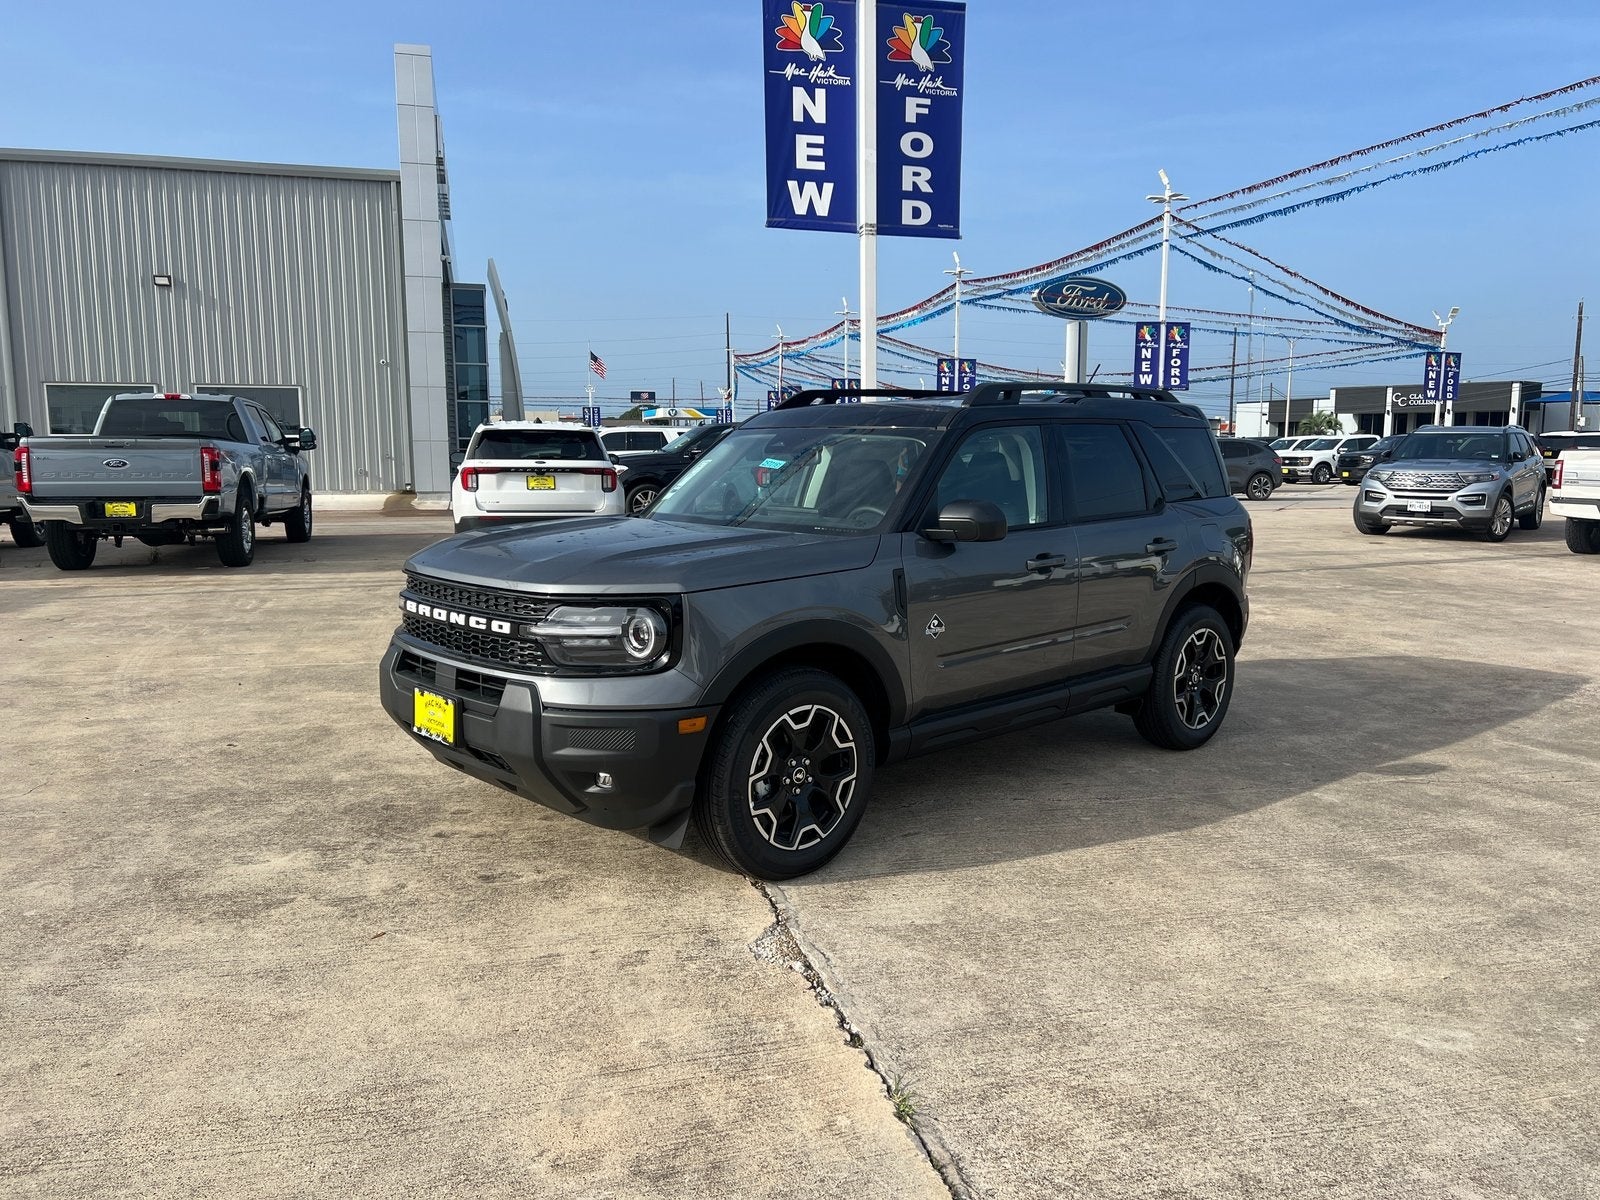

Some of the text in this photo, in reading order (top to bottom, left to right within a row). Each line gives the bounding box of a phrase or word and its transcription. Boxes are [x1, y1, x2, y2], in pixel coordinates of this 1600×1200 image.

[783, 62, 844, 83] Mac Haik
[816, 77, 851, 86] VICTORIA
[893, 72, 951, 94] Mac Haik
[924, 88, 958, 97] VICTORIA
[786, 86, 834, 217] NEW
[899, 96, 934, 226] FORD
[1055, 284, 1109, 309] Ford
[1139, 348, 1153, 385] NEW
[1170, 348, 1181, 386] FORD
[1426, 371, 1436, 399] NEW
[1446, 372, 1454, 399] FORD
[40, 471, 194, 481] SUPER DUTY
[405, 600, 511, 634] BRONCO
